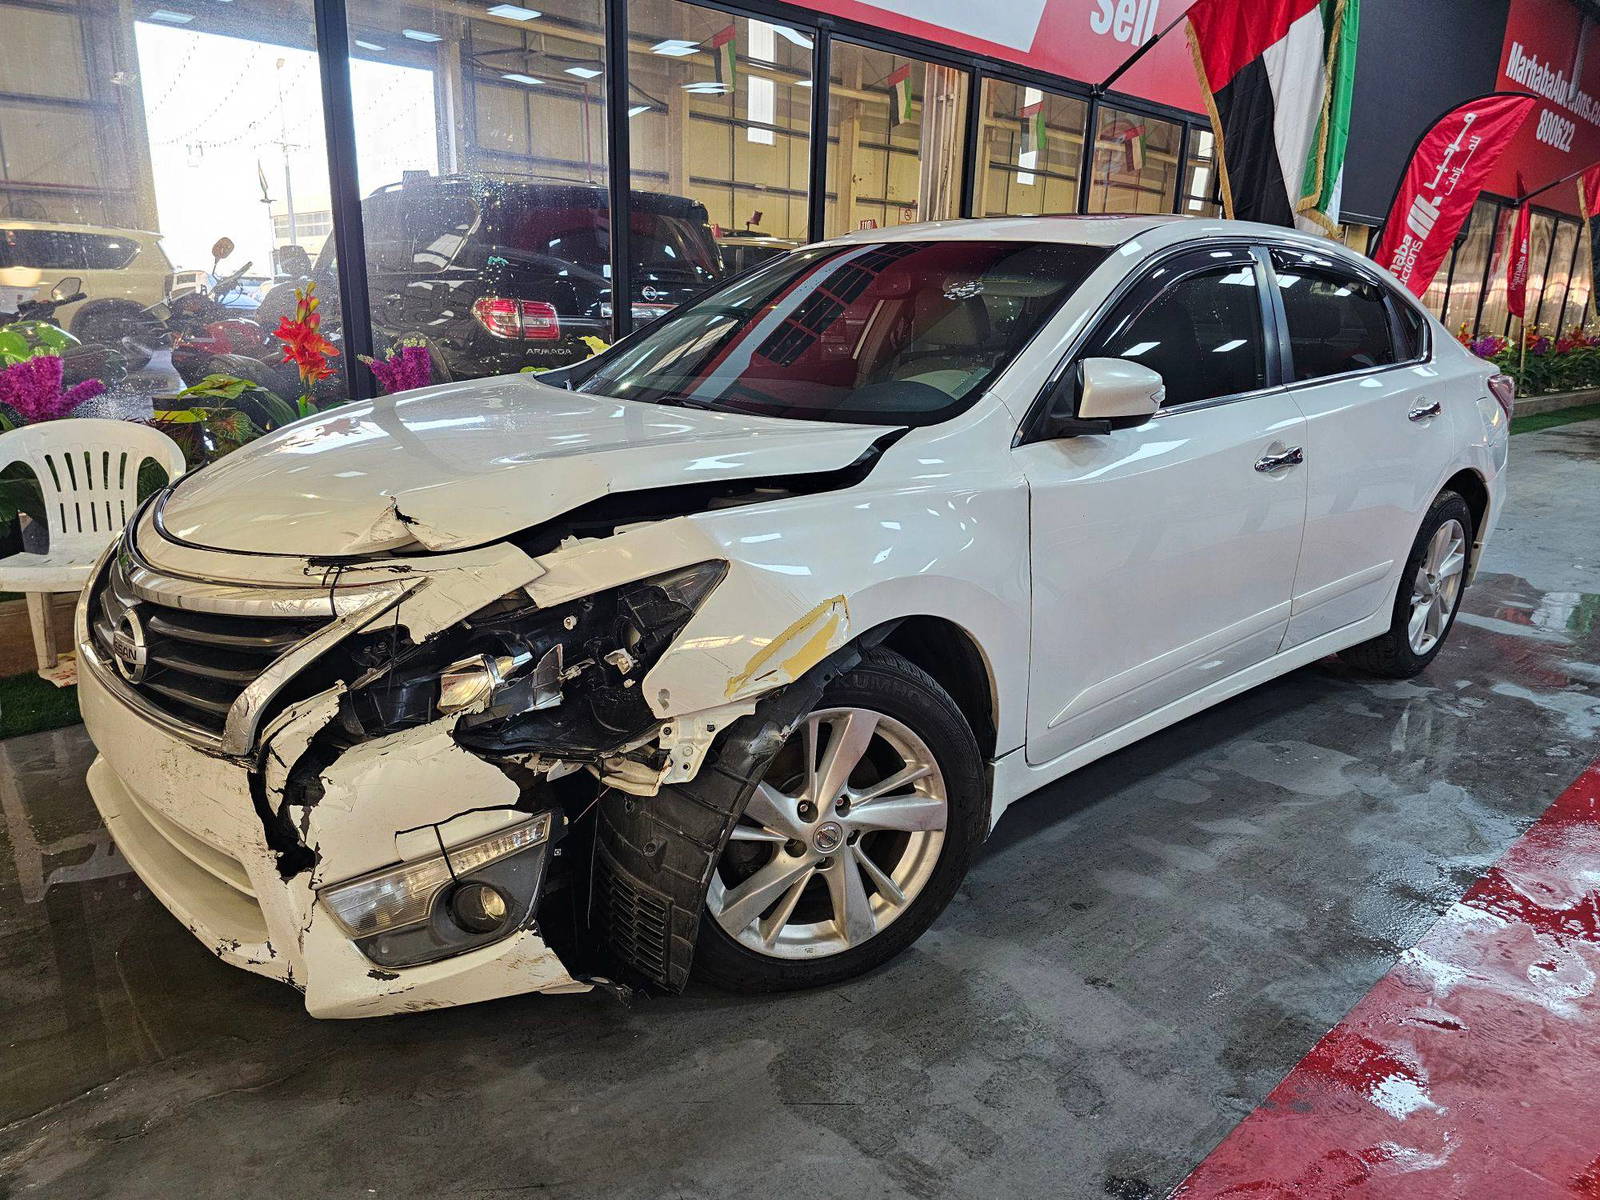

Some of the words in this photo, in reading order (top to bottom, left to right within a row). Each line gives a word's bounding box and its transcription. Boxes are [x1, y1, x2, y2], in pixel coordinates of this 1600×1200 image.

[1090, 0, 1160, 47] Sell
[1424, 112, 1477, 190] مرحبا
[1535, 108, 1576, 153] 800622
